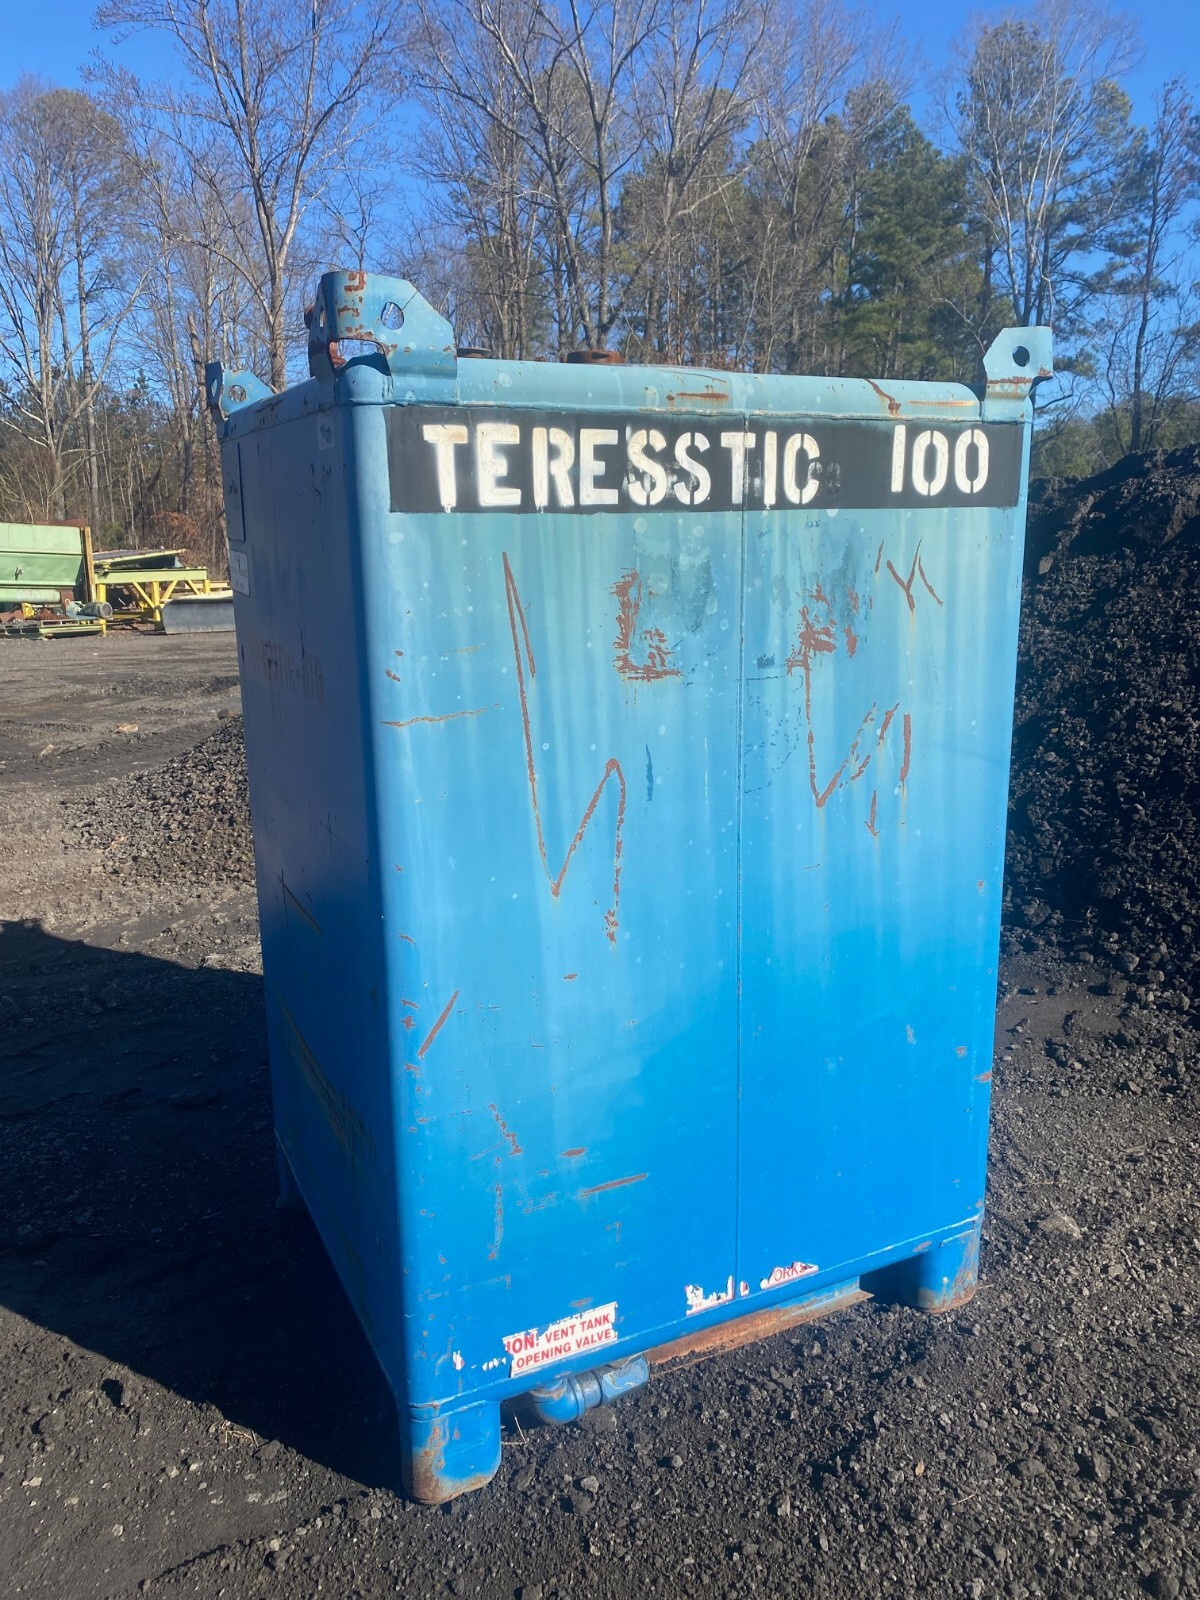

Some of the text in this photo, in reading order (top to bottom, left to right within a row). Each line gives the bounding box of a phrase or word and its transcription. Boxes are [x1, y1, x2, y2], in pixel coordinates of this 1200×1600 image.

[422, 424, 820, 511] TERESSTIC
[891, 424, 989, 496] 100
[516, 1342, 572, 1368] OPENING
[575, 1328, 612, 1349] VALVE
[545, 1324, 576, 1344] VENT
[580, 1313, 611, 1332] TANK
